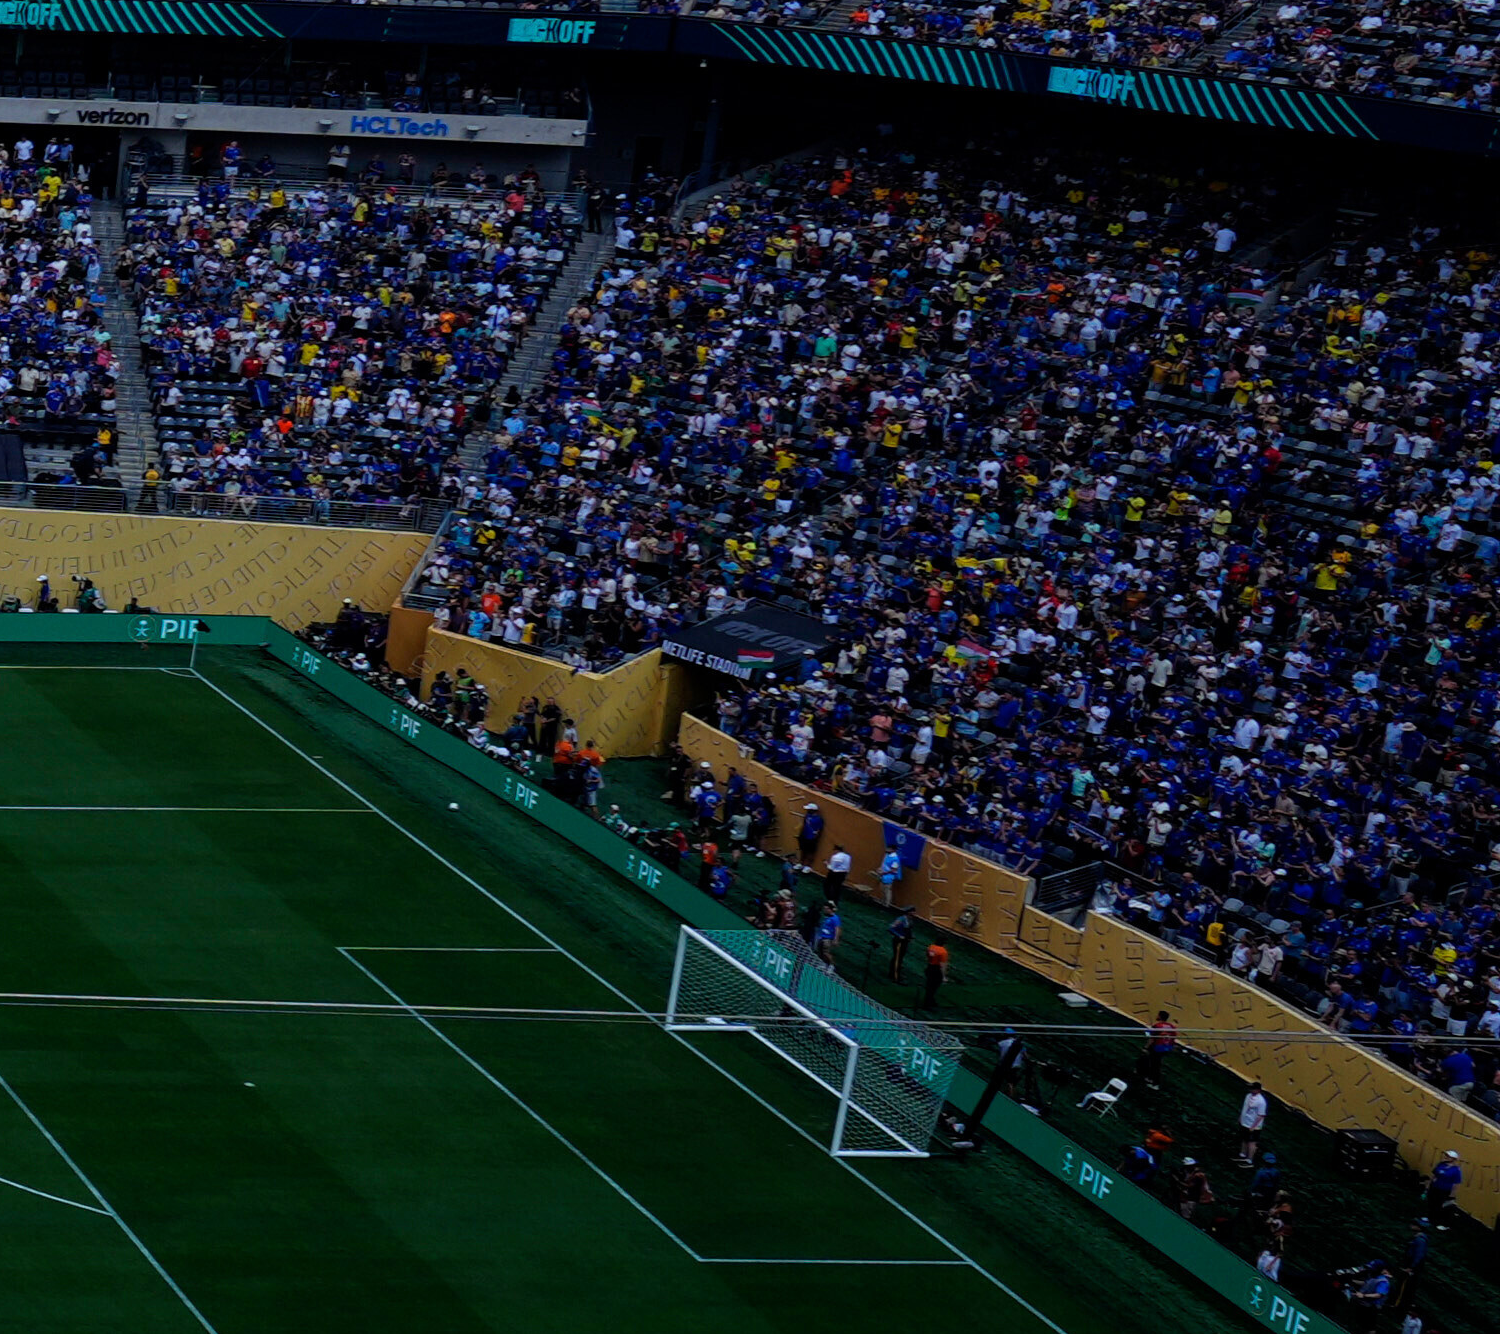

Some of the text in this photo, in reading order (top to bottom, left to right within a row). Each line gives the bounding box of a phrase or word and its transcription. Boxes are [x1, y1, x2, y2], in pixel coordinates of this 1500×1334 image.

[26, 3, 61, 26] OFF
[558, 20, 596, 44] OFF
[1098, 73, 1135, 101] OFF
[75, 108, 150, 126] verizon
[350, 116, 449, 137] HCLTech
[300, 651, 321, 675] PIF
[400, 713, 422, 739] PIF
[515, 782, 540, 809] PIF
[638, 859, 663, 890] PIF
[1078, 1164, 1114, 1200] PIF
